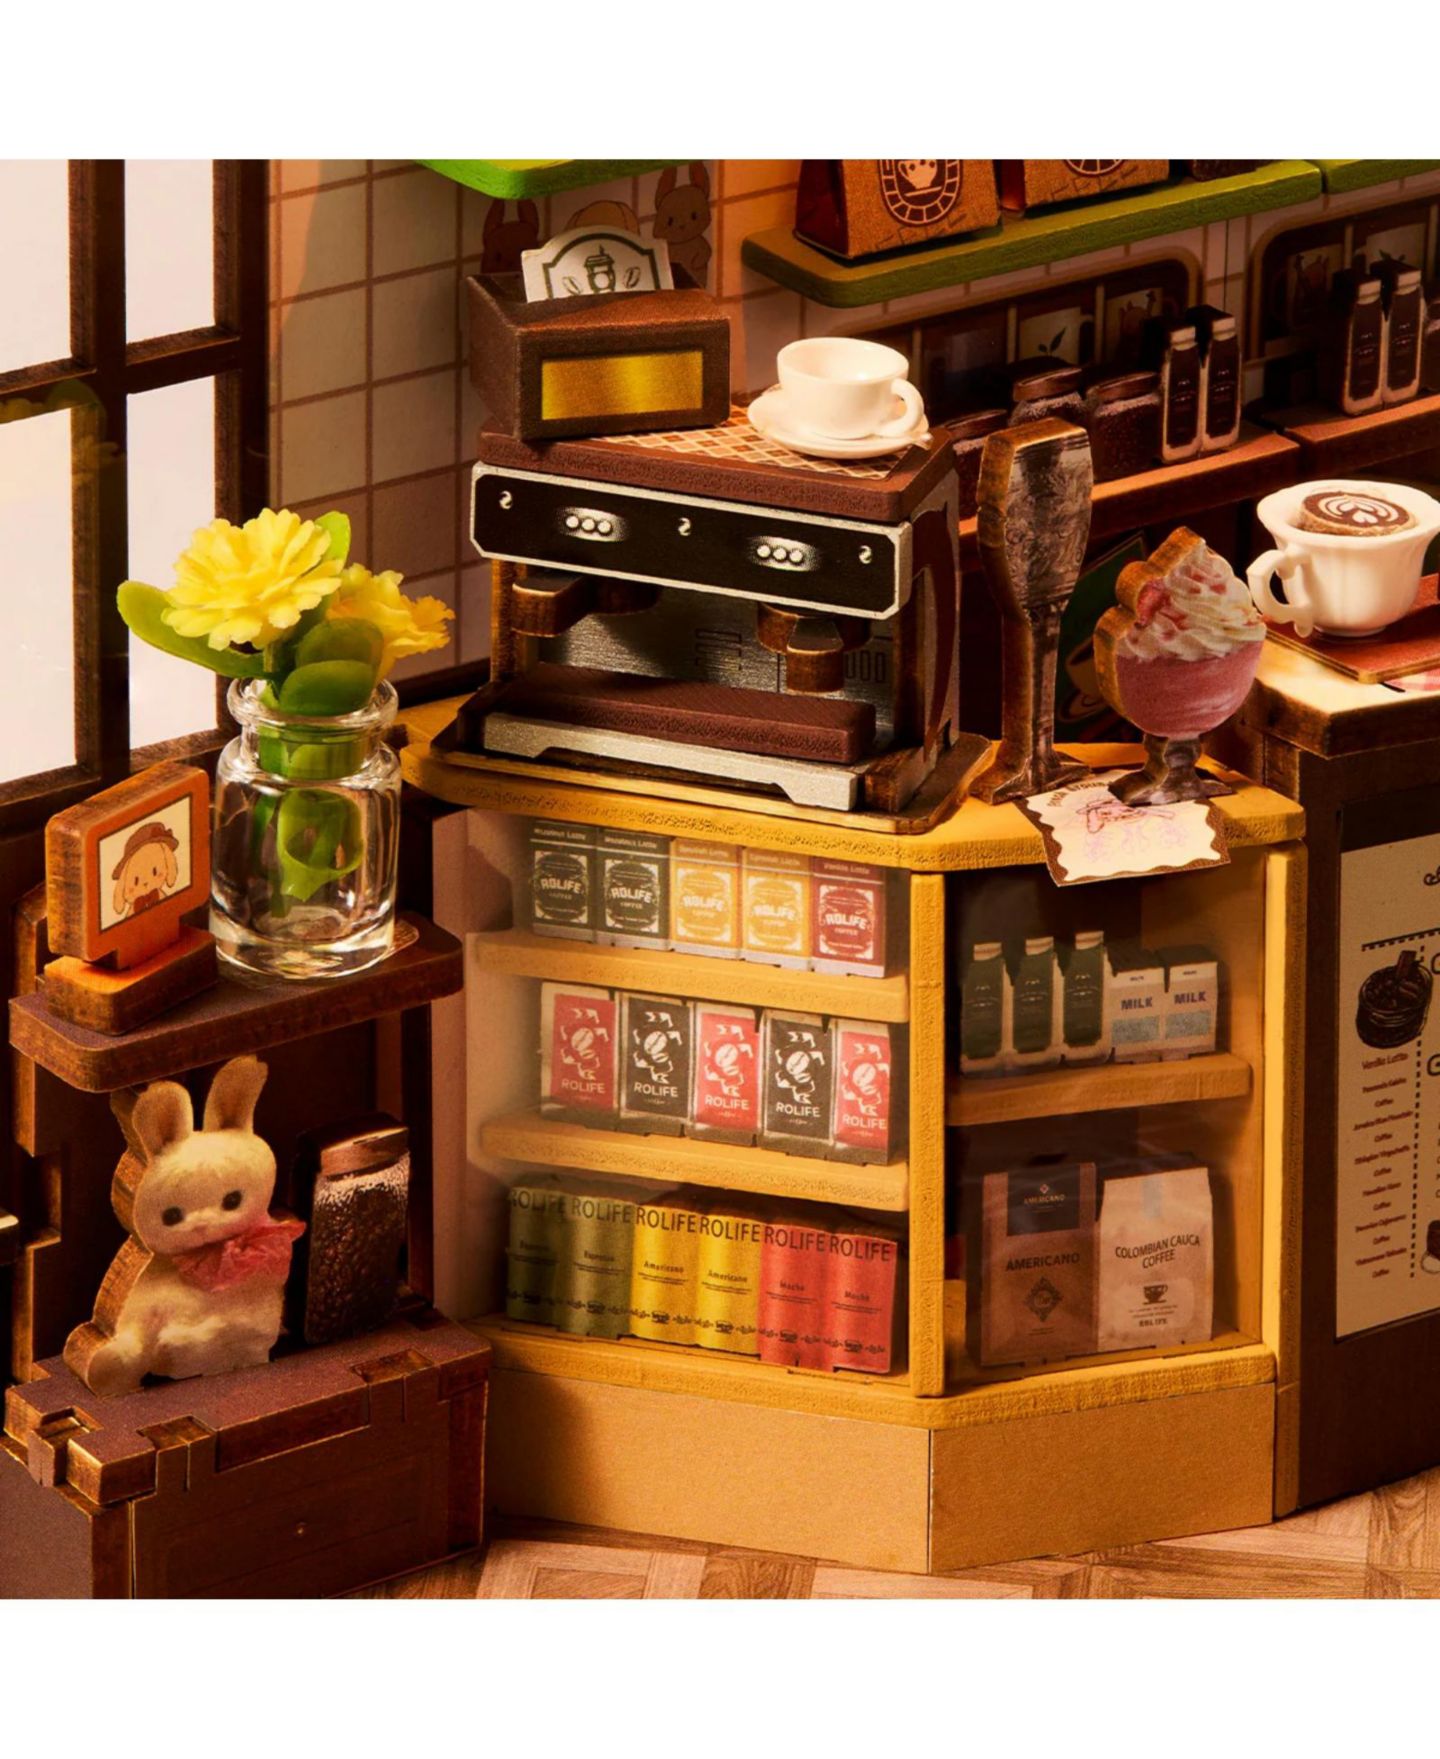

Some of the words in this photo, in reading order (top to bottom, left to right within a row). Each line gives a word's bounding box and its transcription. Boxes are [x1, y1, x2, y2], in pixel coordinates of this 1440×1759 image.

[541, 877, 582, 894] ROLIFE
[611, 886, 653, 904] ROLIFE
[683, 895, 724, 912] ROLIFE
[754, 904, 796, 921] ROLIFE
[825, 913, 869, 930] ROLIFE
[1121, 996, 1153, 1011] MILK
[1174, 991, 1207, 1005] MILK
[561, 1078, 606, 1094] ROLIFE
[634, 1081, 679, 1098] ROLIFE
[704, 1094, 750, 1111] ROLIFE
[775, 1101, 821, 1118] ROLIFE
[842, 1113, 888, 1130] ROLIFE
[1024, 1193, 1066, 1205] AMERICANO
[572, 1198, 631, 1224] ROLIFE
[636, 1206, 697, 1233] ROLIFE
[699, 1216, 761, 1243] ROLIFE
[764, 1226, 826, 1252] ROLIFE
[1115, 1237, 1169, 1259] COLOMBIAN
[1169, 1233, 1201, 1248] CAUCA
[830, 1235, 891, 1262] ROLIFE
[644, 1260, 685, 1274] Americano
[1006, 1251, 1081, 1272] AMERICANO
[1142, 1248, 1176, 1269] COFFEE
